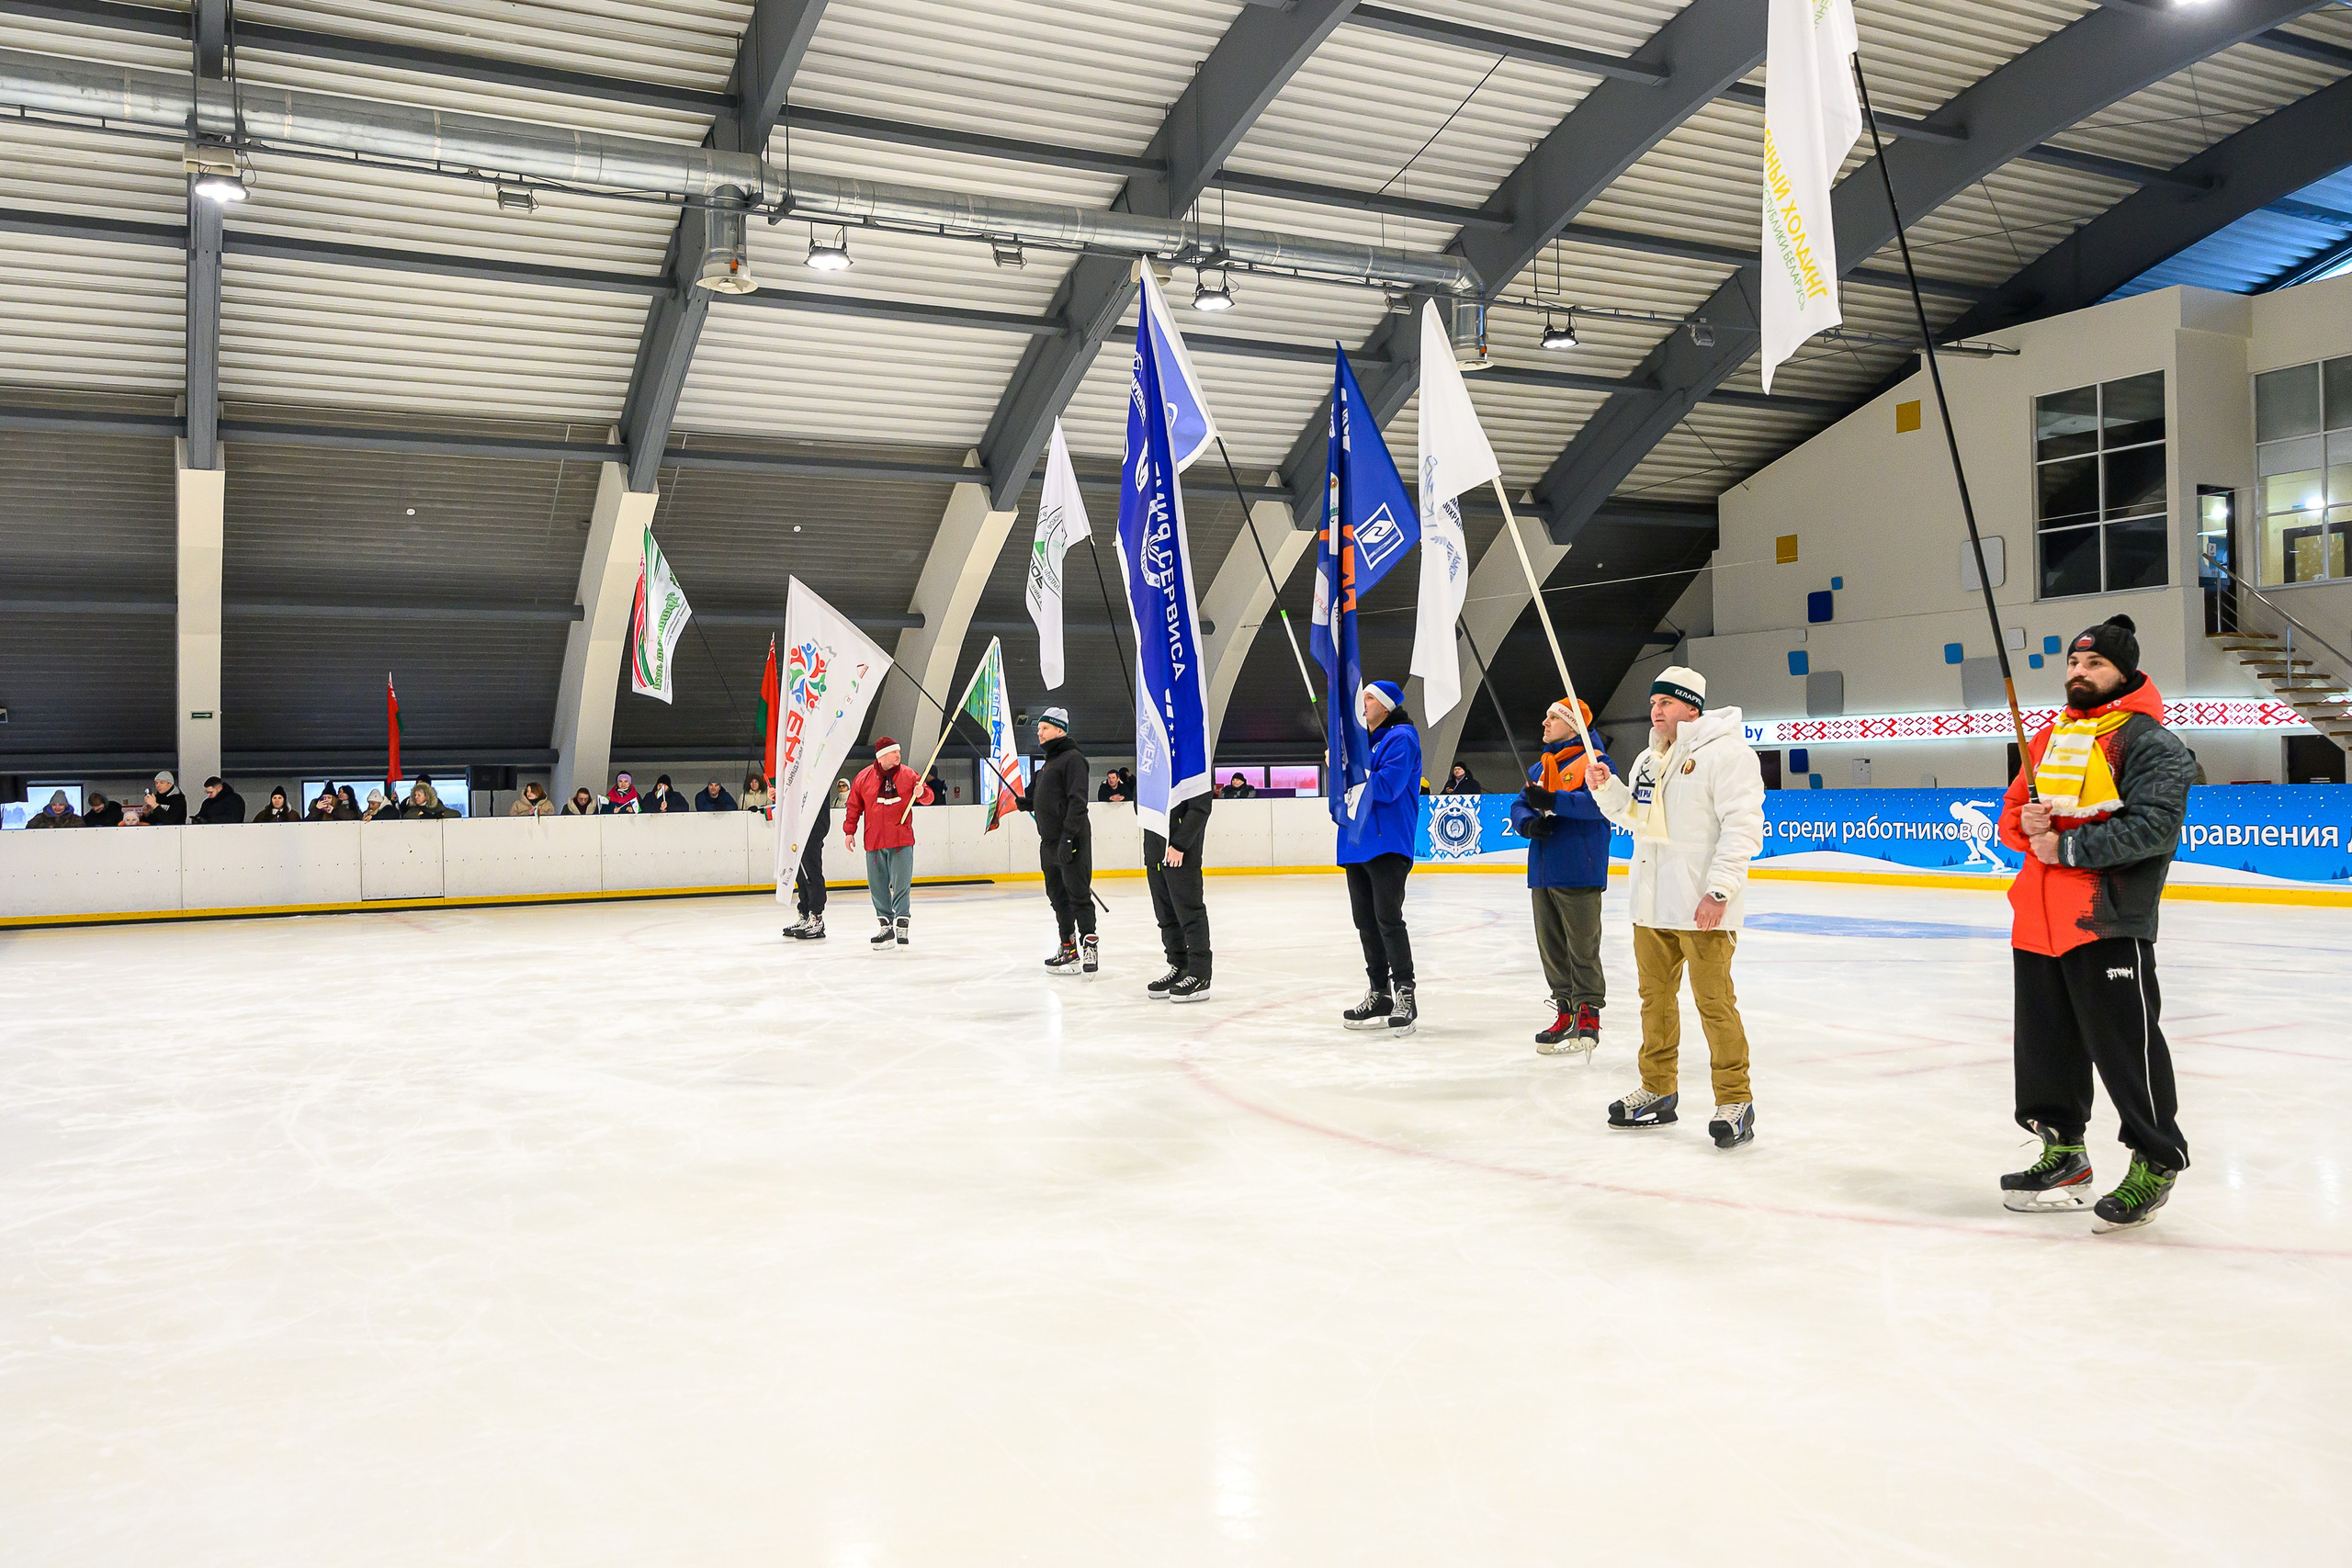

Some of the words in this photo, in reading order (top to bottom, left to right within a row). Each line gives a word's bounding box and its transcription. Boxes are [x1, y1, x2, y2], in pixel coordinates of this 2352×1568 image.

[1781, 198, 1828, 299] ХОЛДИНГ
[1782, 249, 1807, 312] БЕЛАРУСЬ
[1159, 548, 1186, 682] СЕРВИСА
[1745, 725, 1764, 741] by
[1501, 818, 1521, 837] 2
[1778, 820, 1837, 843] среди
[1842, 814, 1973, 844] работников
